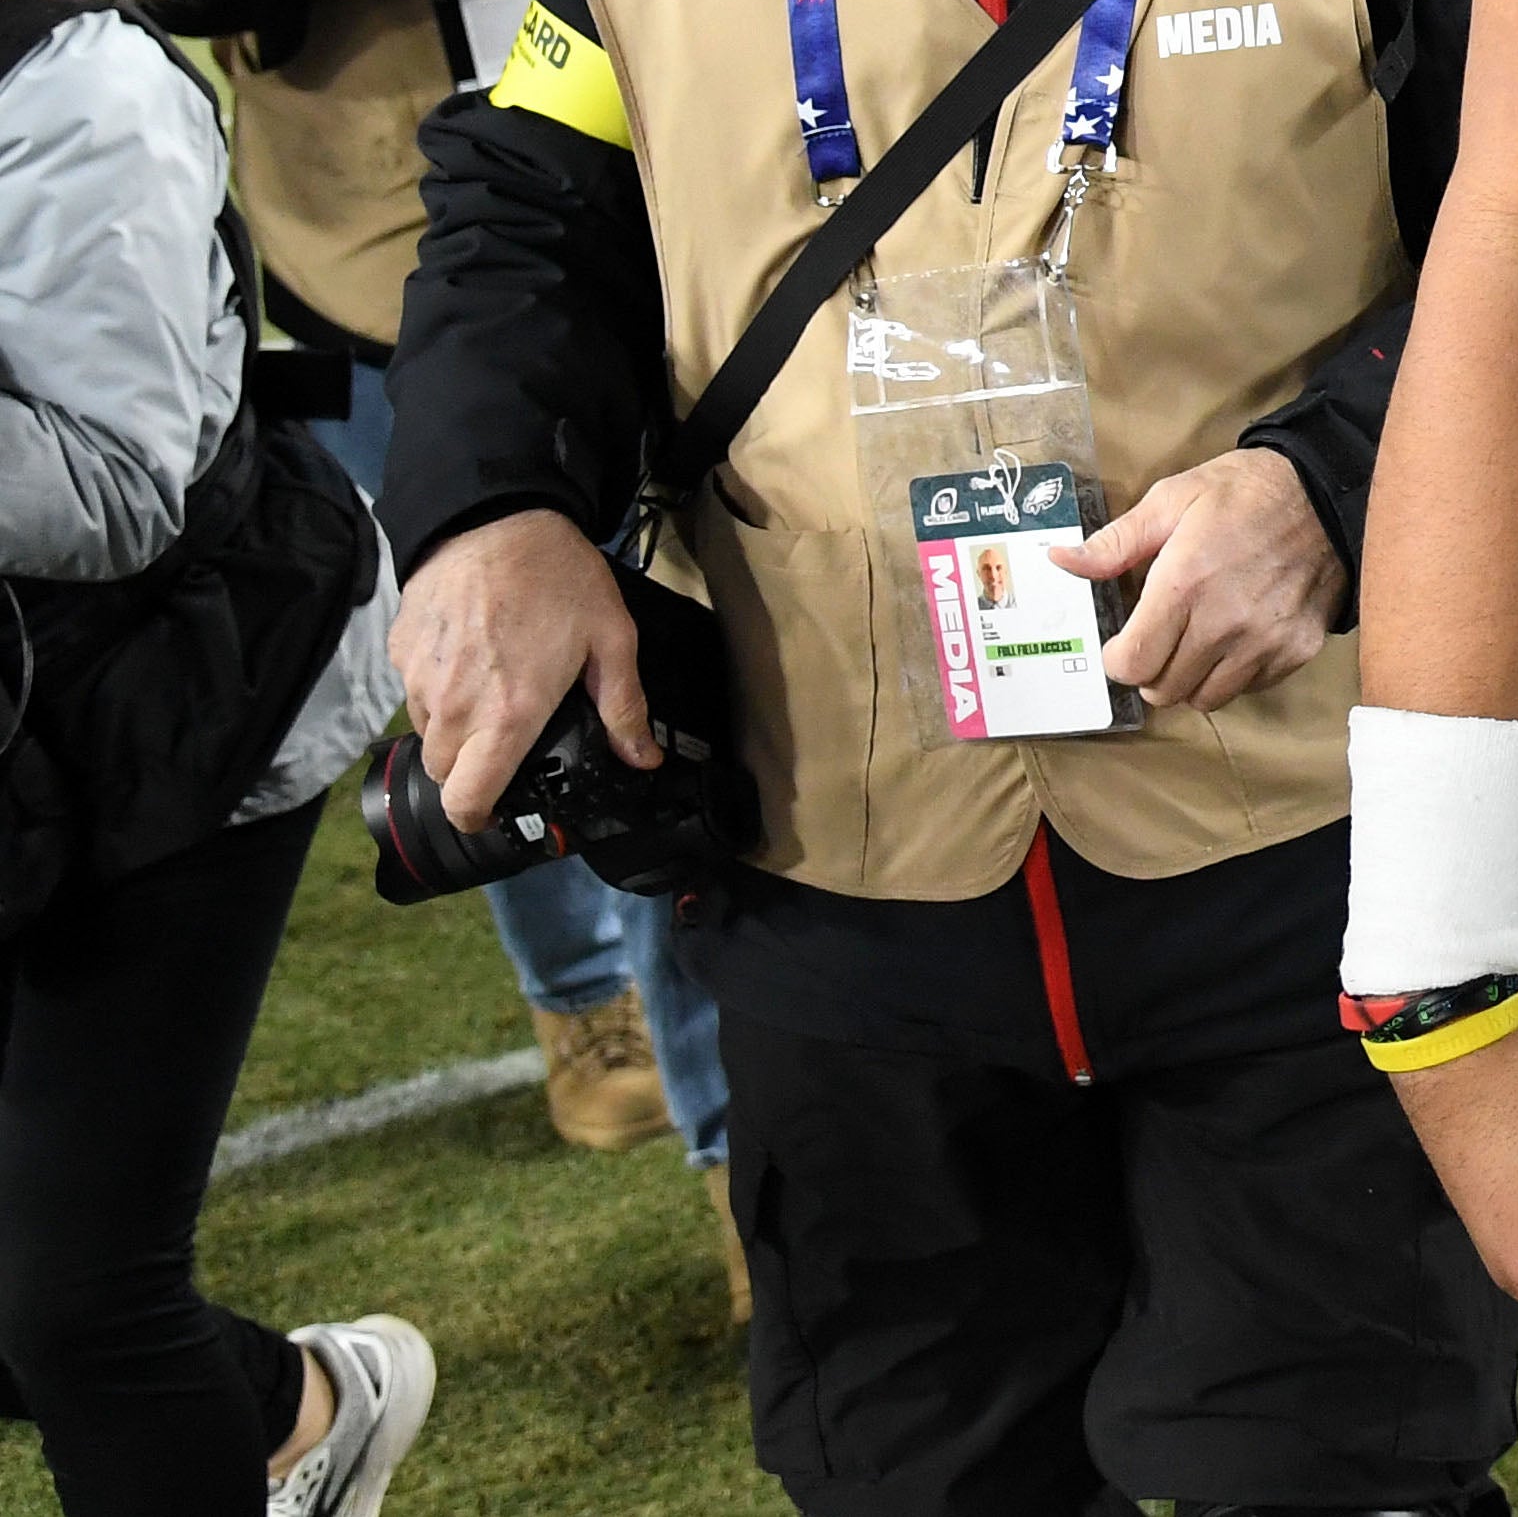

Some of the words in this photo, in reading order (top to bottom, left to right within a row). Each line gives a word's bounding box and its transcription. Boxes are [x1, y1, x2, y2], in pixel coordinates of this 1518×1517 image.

[1156, 2, 1283, 59] MEDIA
[927, 554, 979, 724] MEDIA
[997, 643, 1017, 658] FULL
[1017, 642, 1039, 656] FIELD
[1041, 639, 1073, 654] ACCESS
